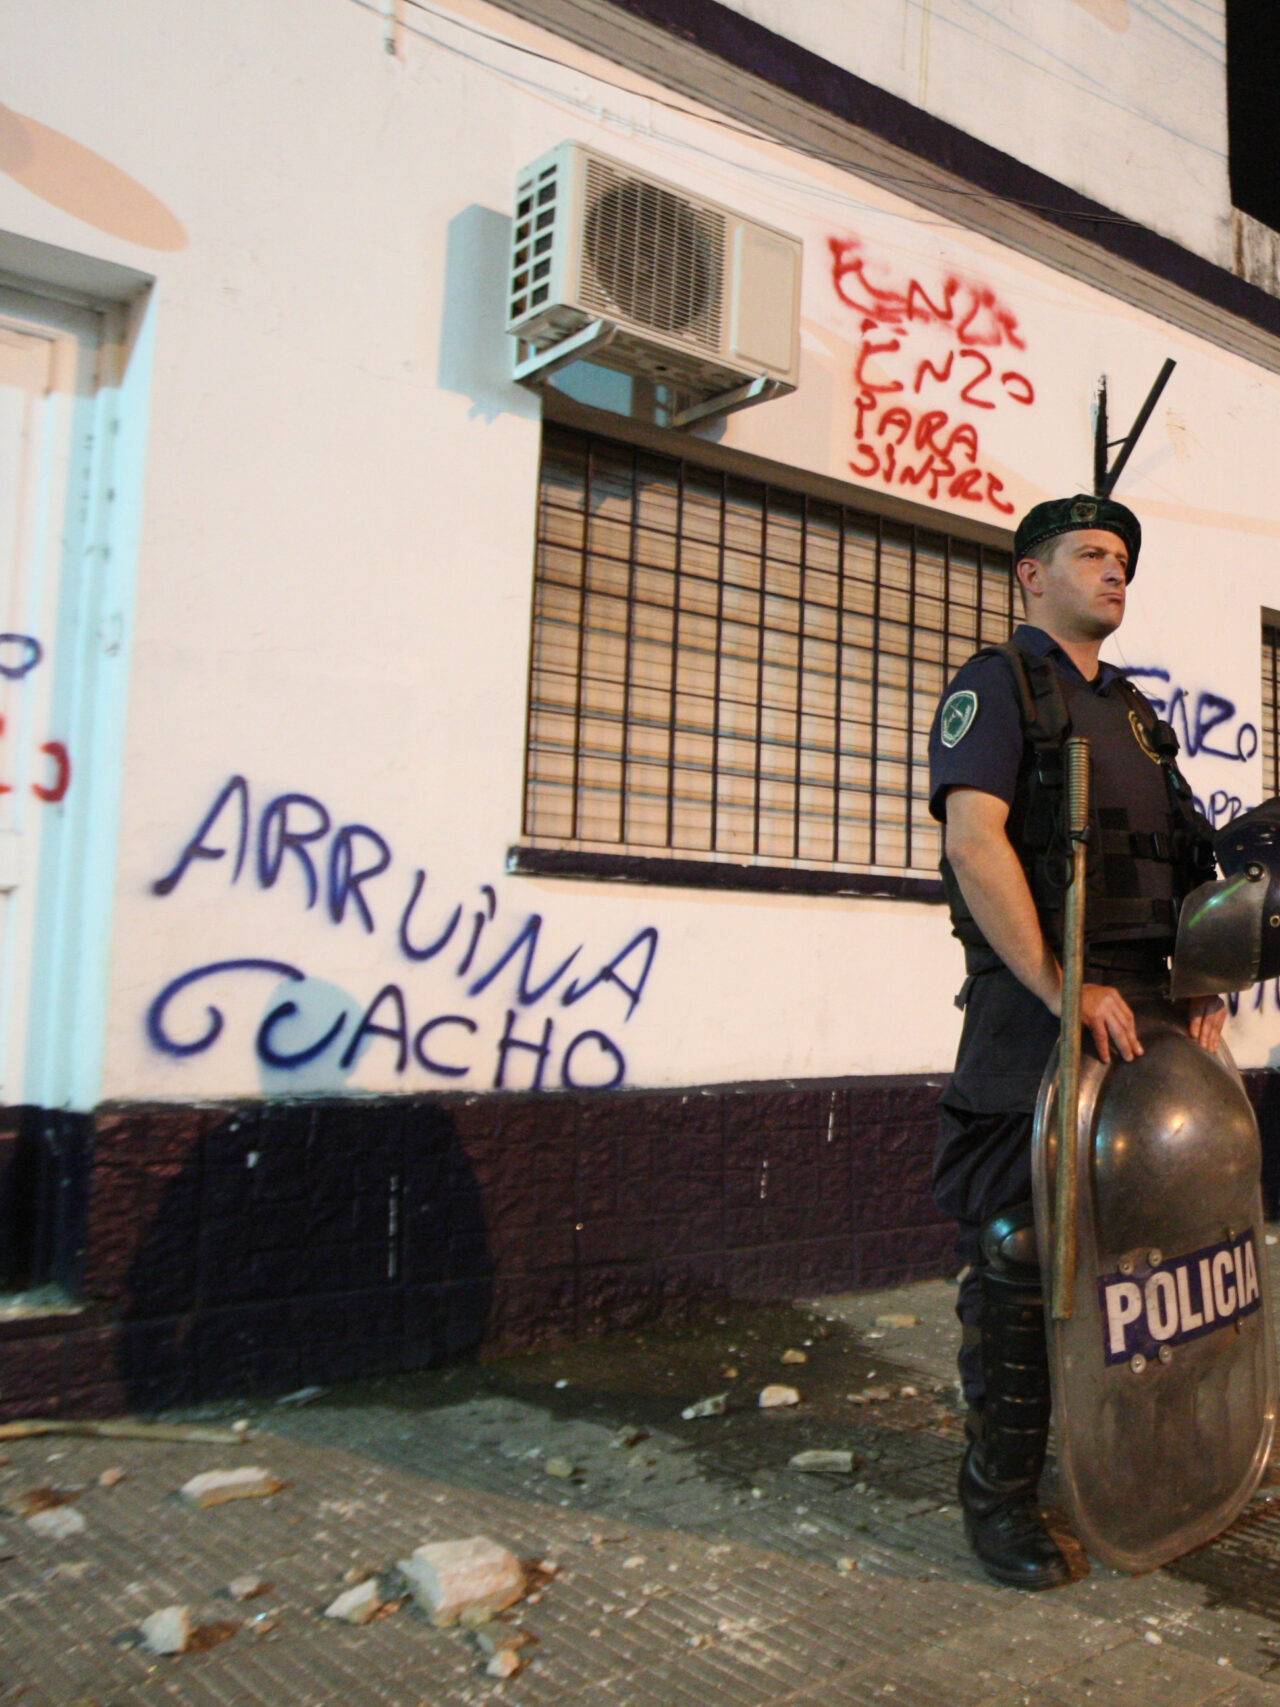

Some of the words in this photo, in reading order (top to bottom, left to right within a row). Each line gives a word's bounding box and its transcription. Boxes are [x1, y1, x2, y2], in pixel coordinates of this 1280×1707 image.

[854, 391, 978, 463] PARA
[152, 775, 658, 1020] ARRUINA
[1105, 1240, 1259, 1354] POLICIA
